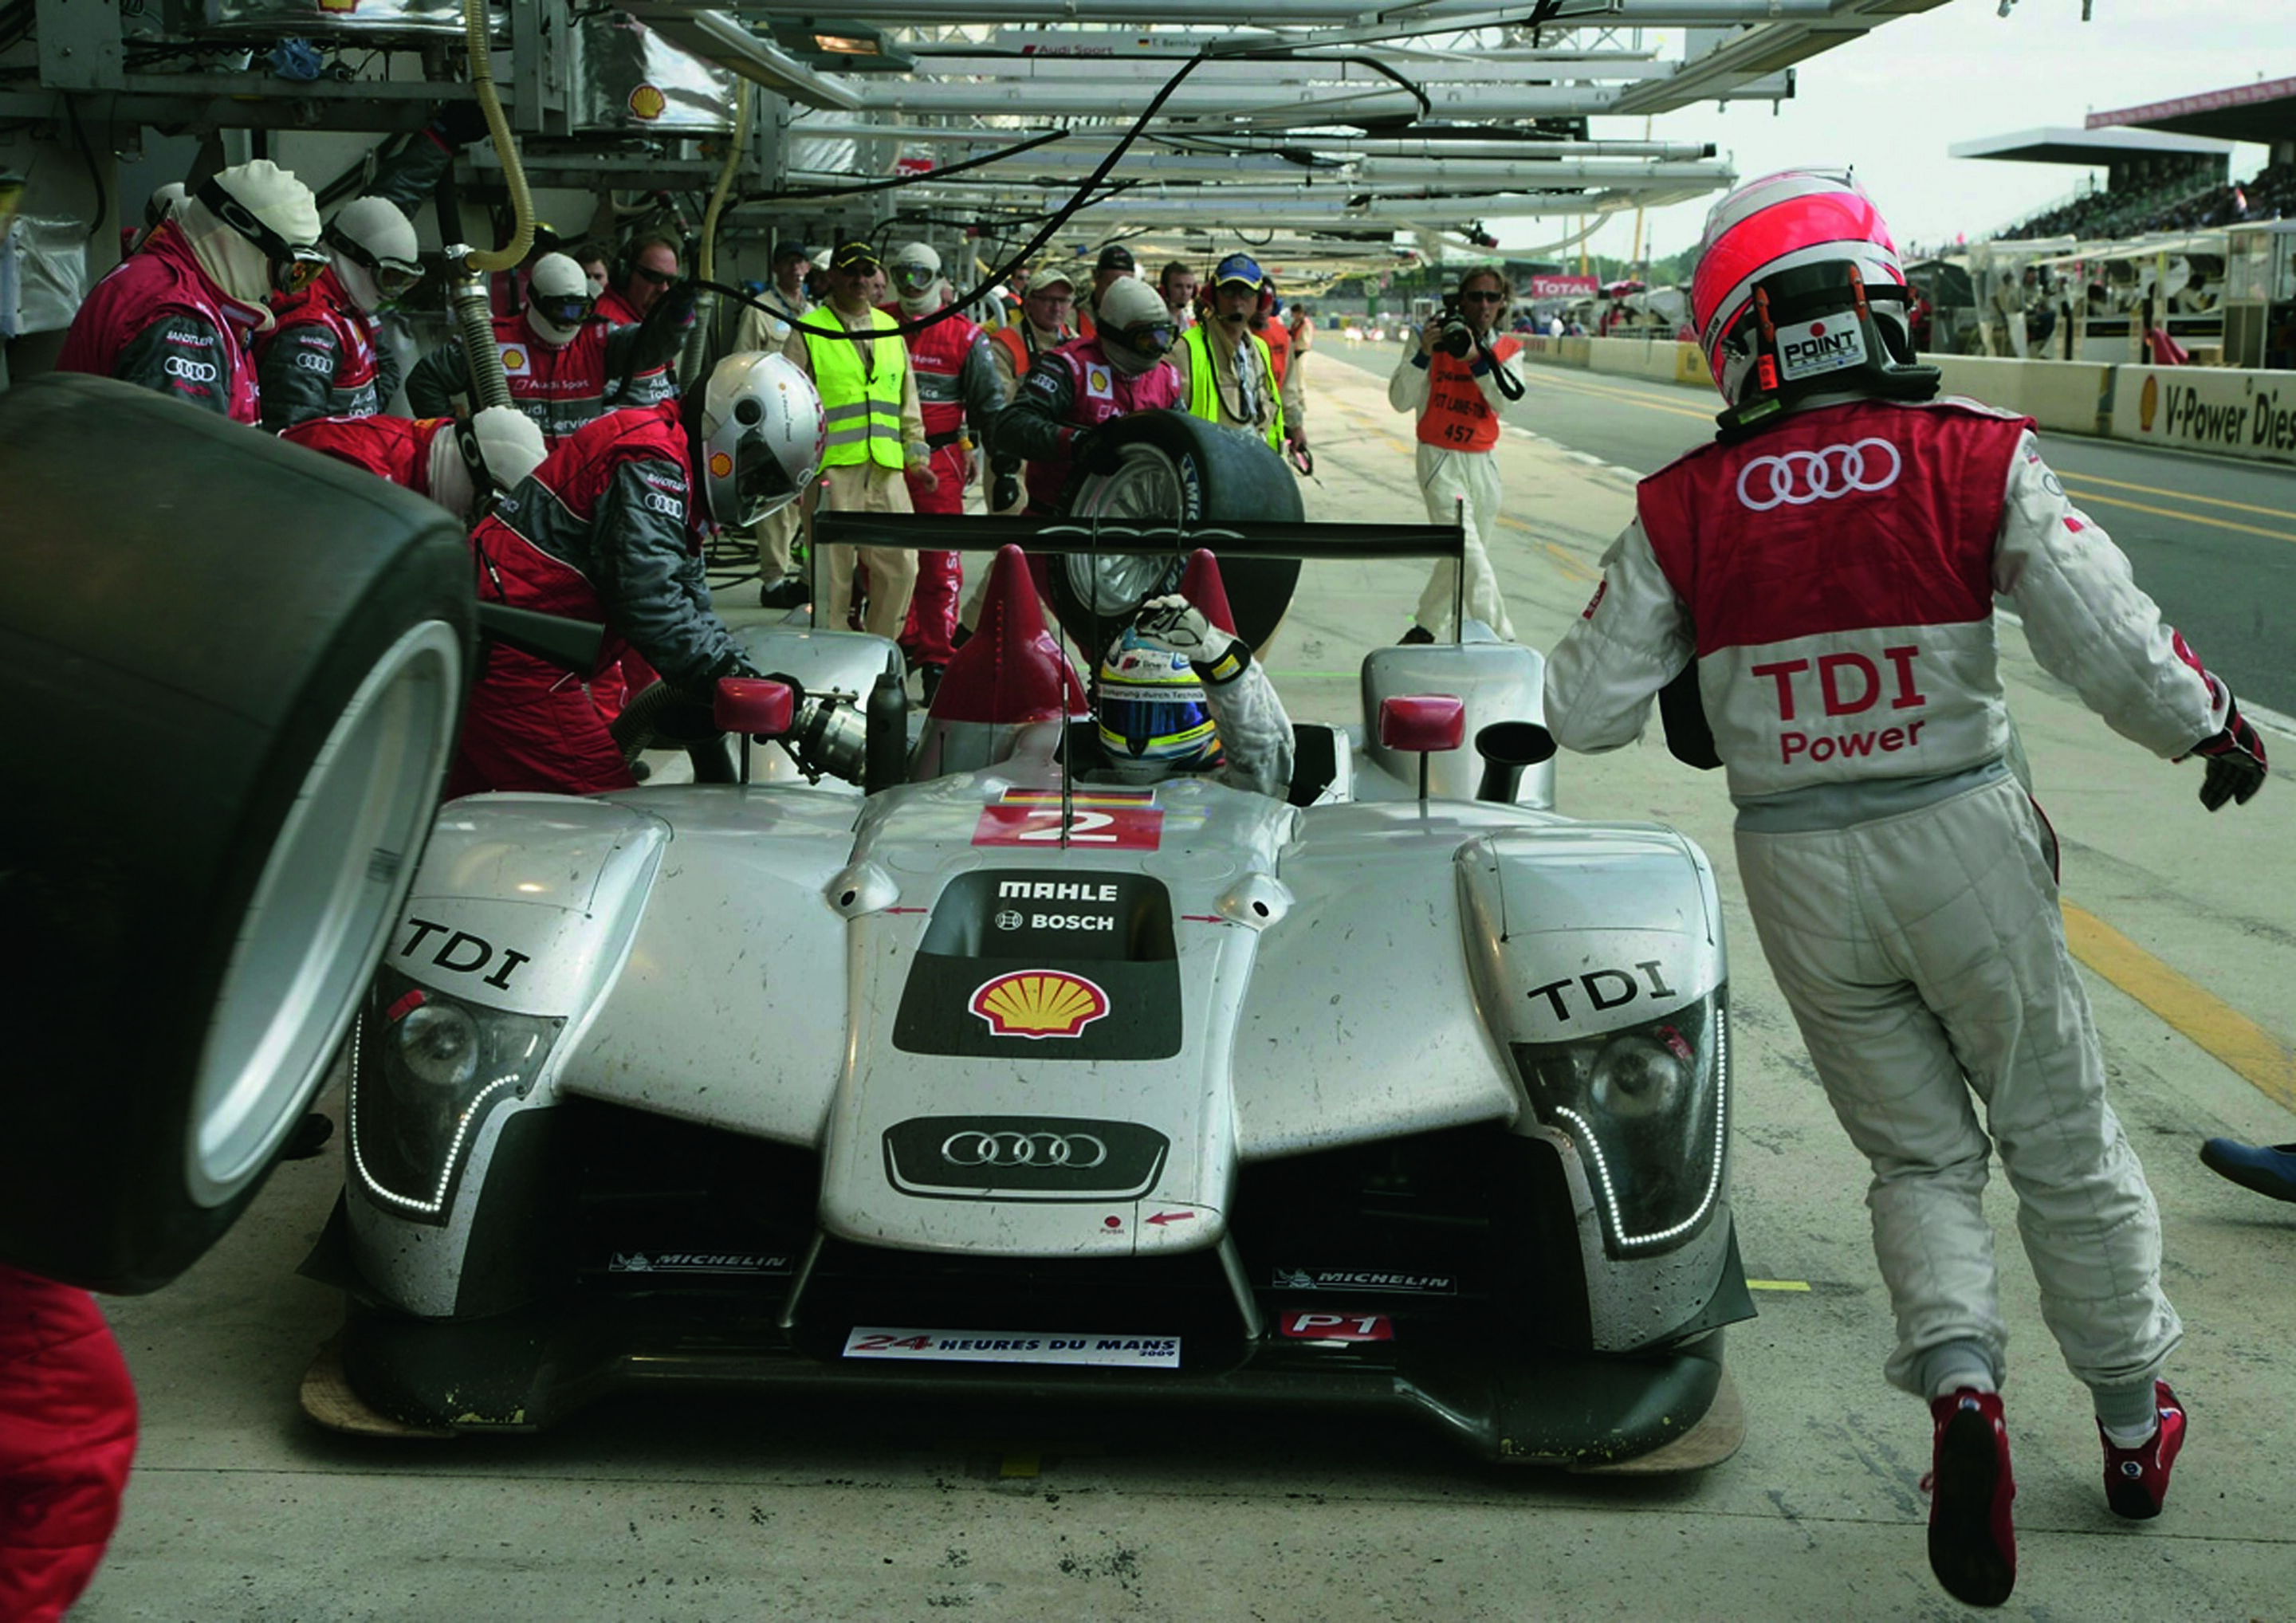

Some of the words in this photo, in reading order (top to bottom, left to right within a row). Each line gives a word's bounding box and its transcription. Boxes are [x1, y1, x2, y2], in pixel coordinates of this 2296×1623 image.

[1038, 45, 1071, 54] Audi
[1074, 45, 1114, 55] Sport
[1534, 281, 1594, 294] TOTAL
[1783, 329, 1855, 360] POINT
[530, 379, 560, 390] Audi
[2166, 383, 2247, 444] V-Power
[1444, 424, 1474, 442] 457
[1751, 645, 1926, 721] TDI
[1779, 720, 1925, 765] Power
[1019, 810, 1118, 842] 2
[998, 881, 1118, 902] MAHLE
[1032, 914, 1115, 931] BOSCH
[400, 918, 531, 991] TDI
[1527, 960, 1677, 1022] TDI
[655, 1254, 788, 1267] MICHELIN
[1318, 1272, 1450, 1287] MICHELIN
[1292, 1314, 1378, 1334] P1
[851, 1334, 933, 1351] 24
[938, 1339, 1040, 1351] HEURES
[1048, 1340, 1087, 1350] DU
[1096, 1340, 1177, 1351] MANS
